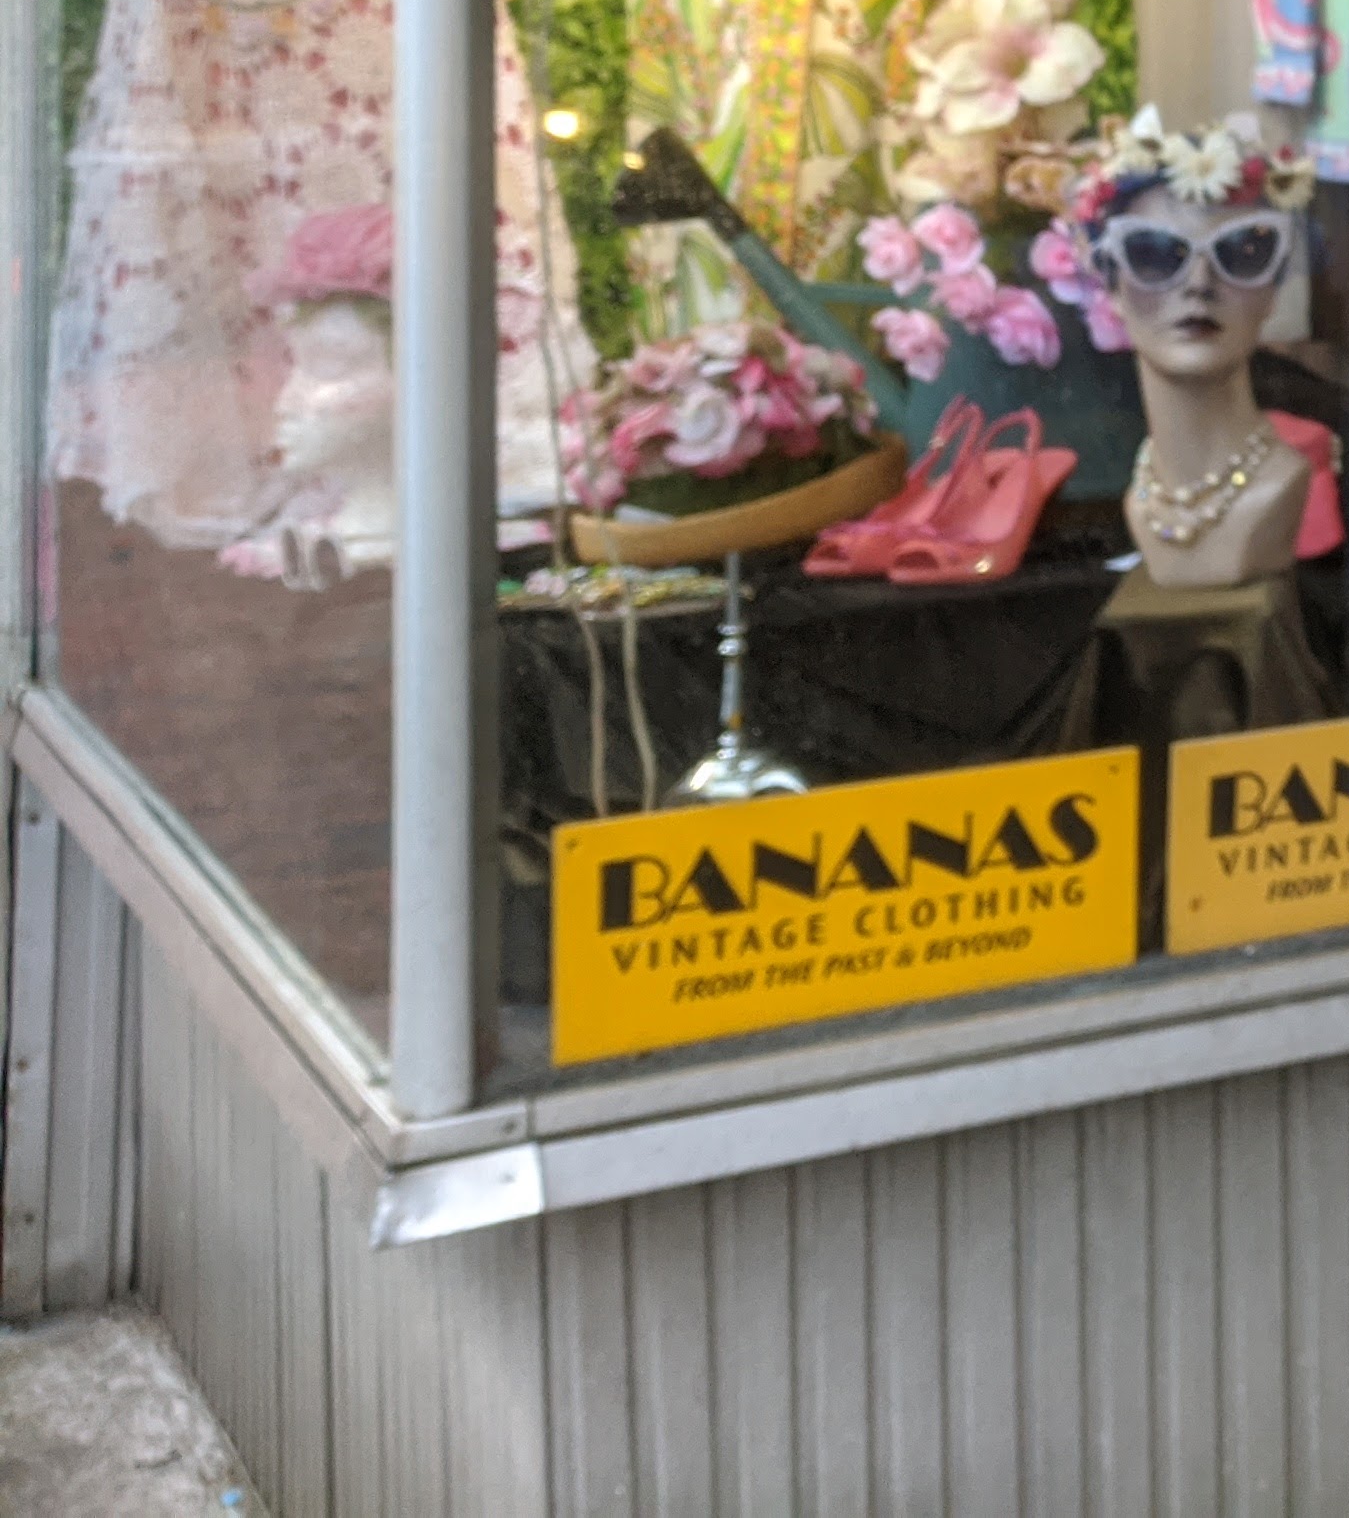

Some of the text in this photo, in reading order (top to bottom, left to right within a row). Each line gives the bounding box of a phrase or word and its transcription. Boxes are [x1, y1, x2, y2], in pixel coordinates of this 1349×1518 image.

[599, 792, 1101, 934] BANANAS
[1266, 877, 1334, 903] FROM
[612, 876, 1086, 975] VINTAGE CLOTHING
[671, 926, 1033, 1005] FROM THE PAST & BEYOND
